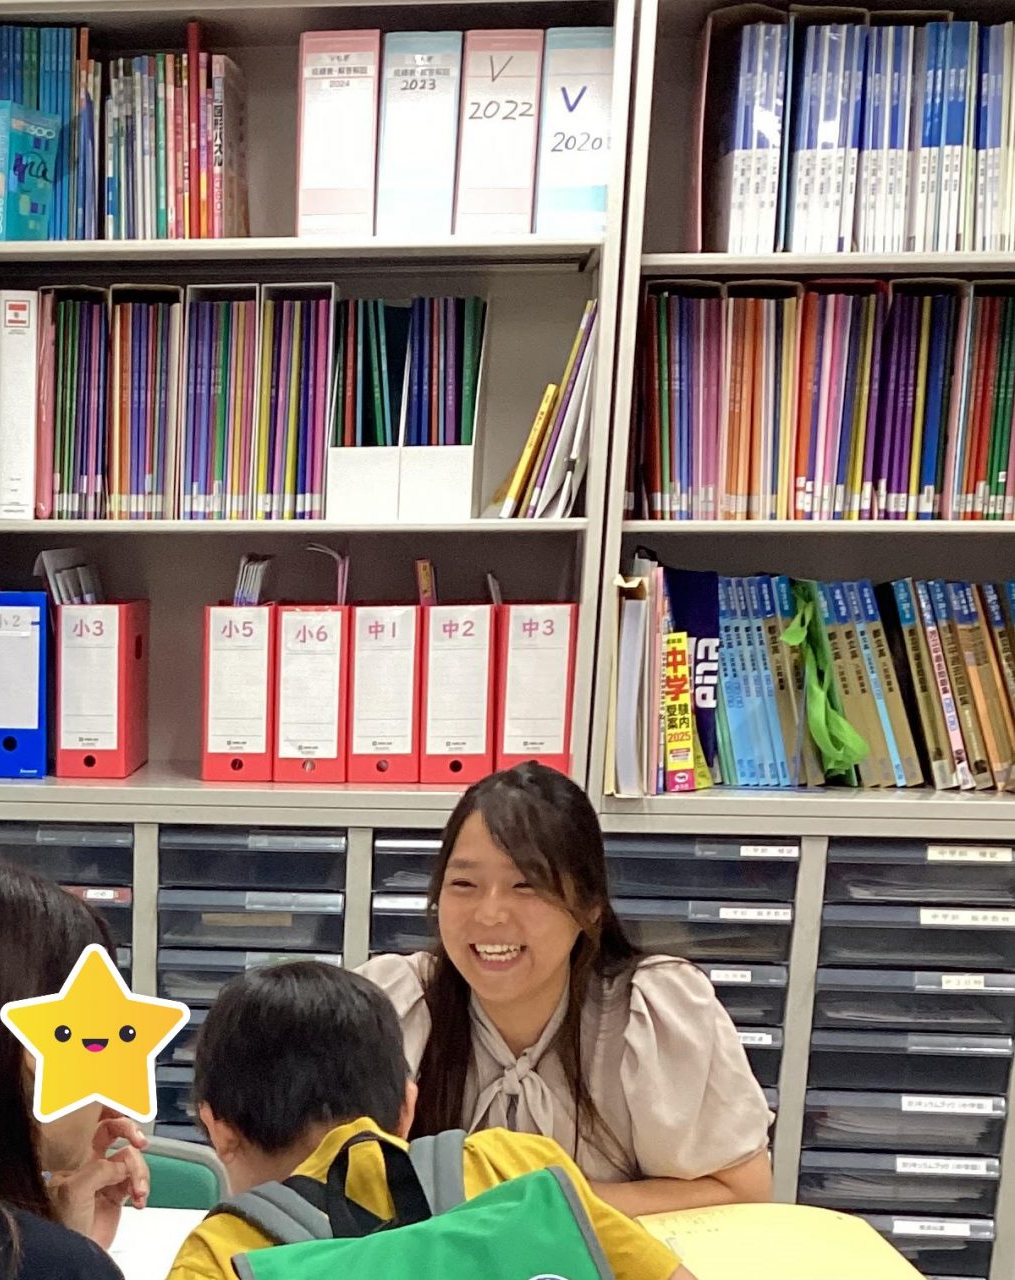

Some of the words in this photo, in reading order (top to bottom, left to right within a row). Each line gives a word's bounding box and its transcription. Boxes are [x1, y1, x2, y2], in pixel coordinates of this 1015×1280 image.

[400, 78, 437, 91] 2023
[468, 99, 534, 120] 2022
[550, 131, 603, 152] 2020
[73, 619, 104, 638] 小3
[221, 620, 254, 638] 小5
[295, 624, 328, 643] 小6
[368, 620, 397, 640] 中1
[442, 619, 475, 639] 中2
[522, 618, 555, 638] 中3
[666, 647, 689, 702] 中学
[695, 637, 720, 708] ena
[667, 704, 690, 717] 受験
[667, 717, 690, 730] 案内
[667, 731, 691, 743] 2025
